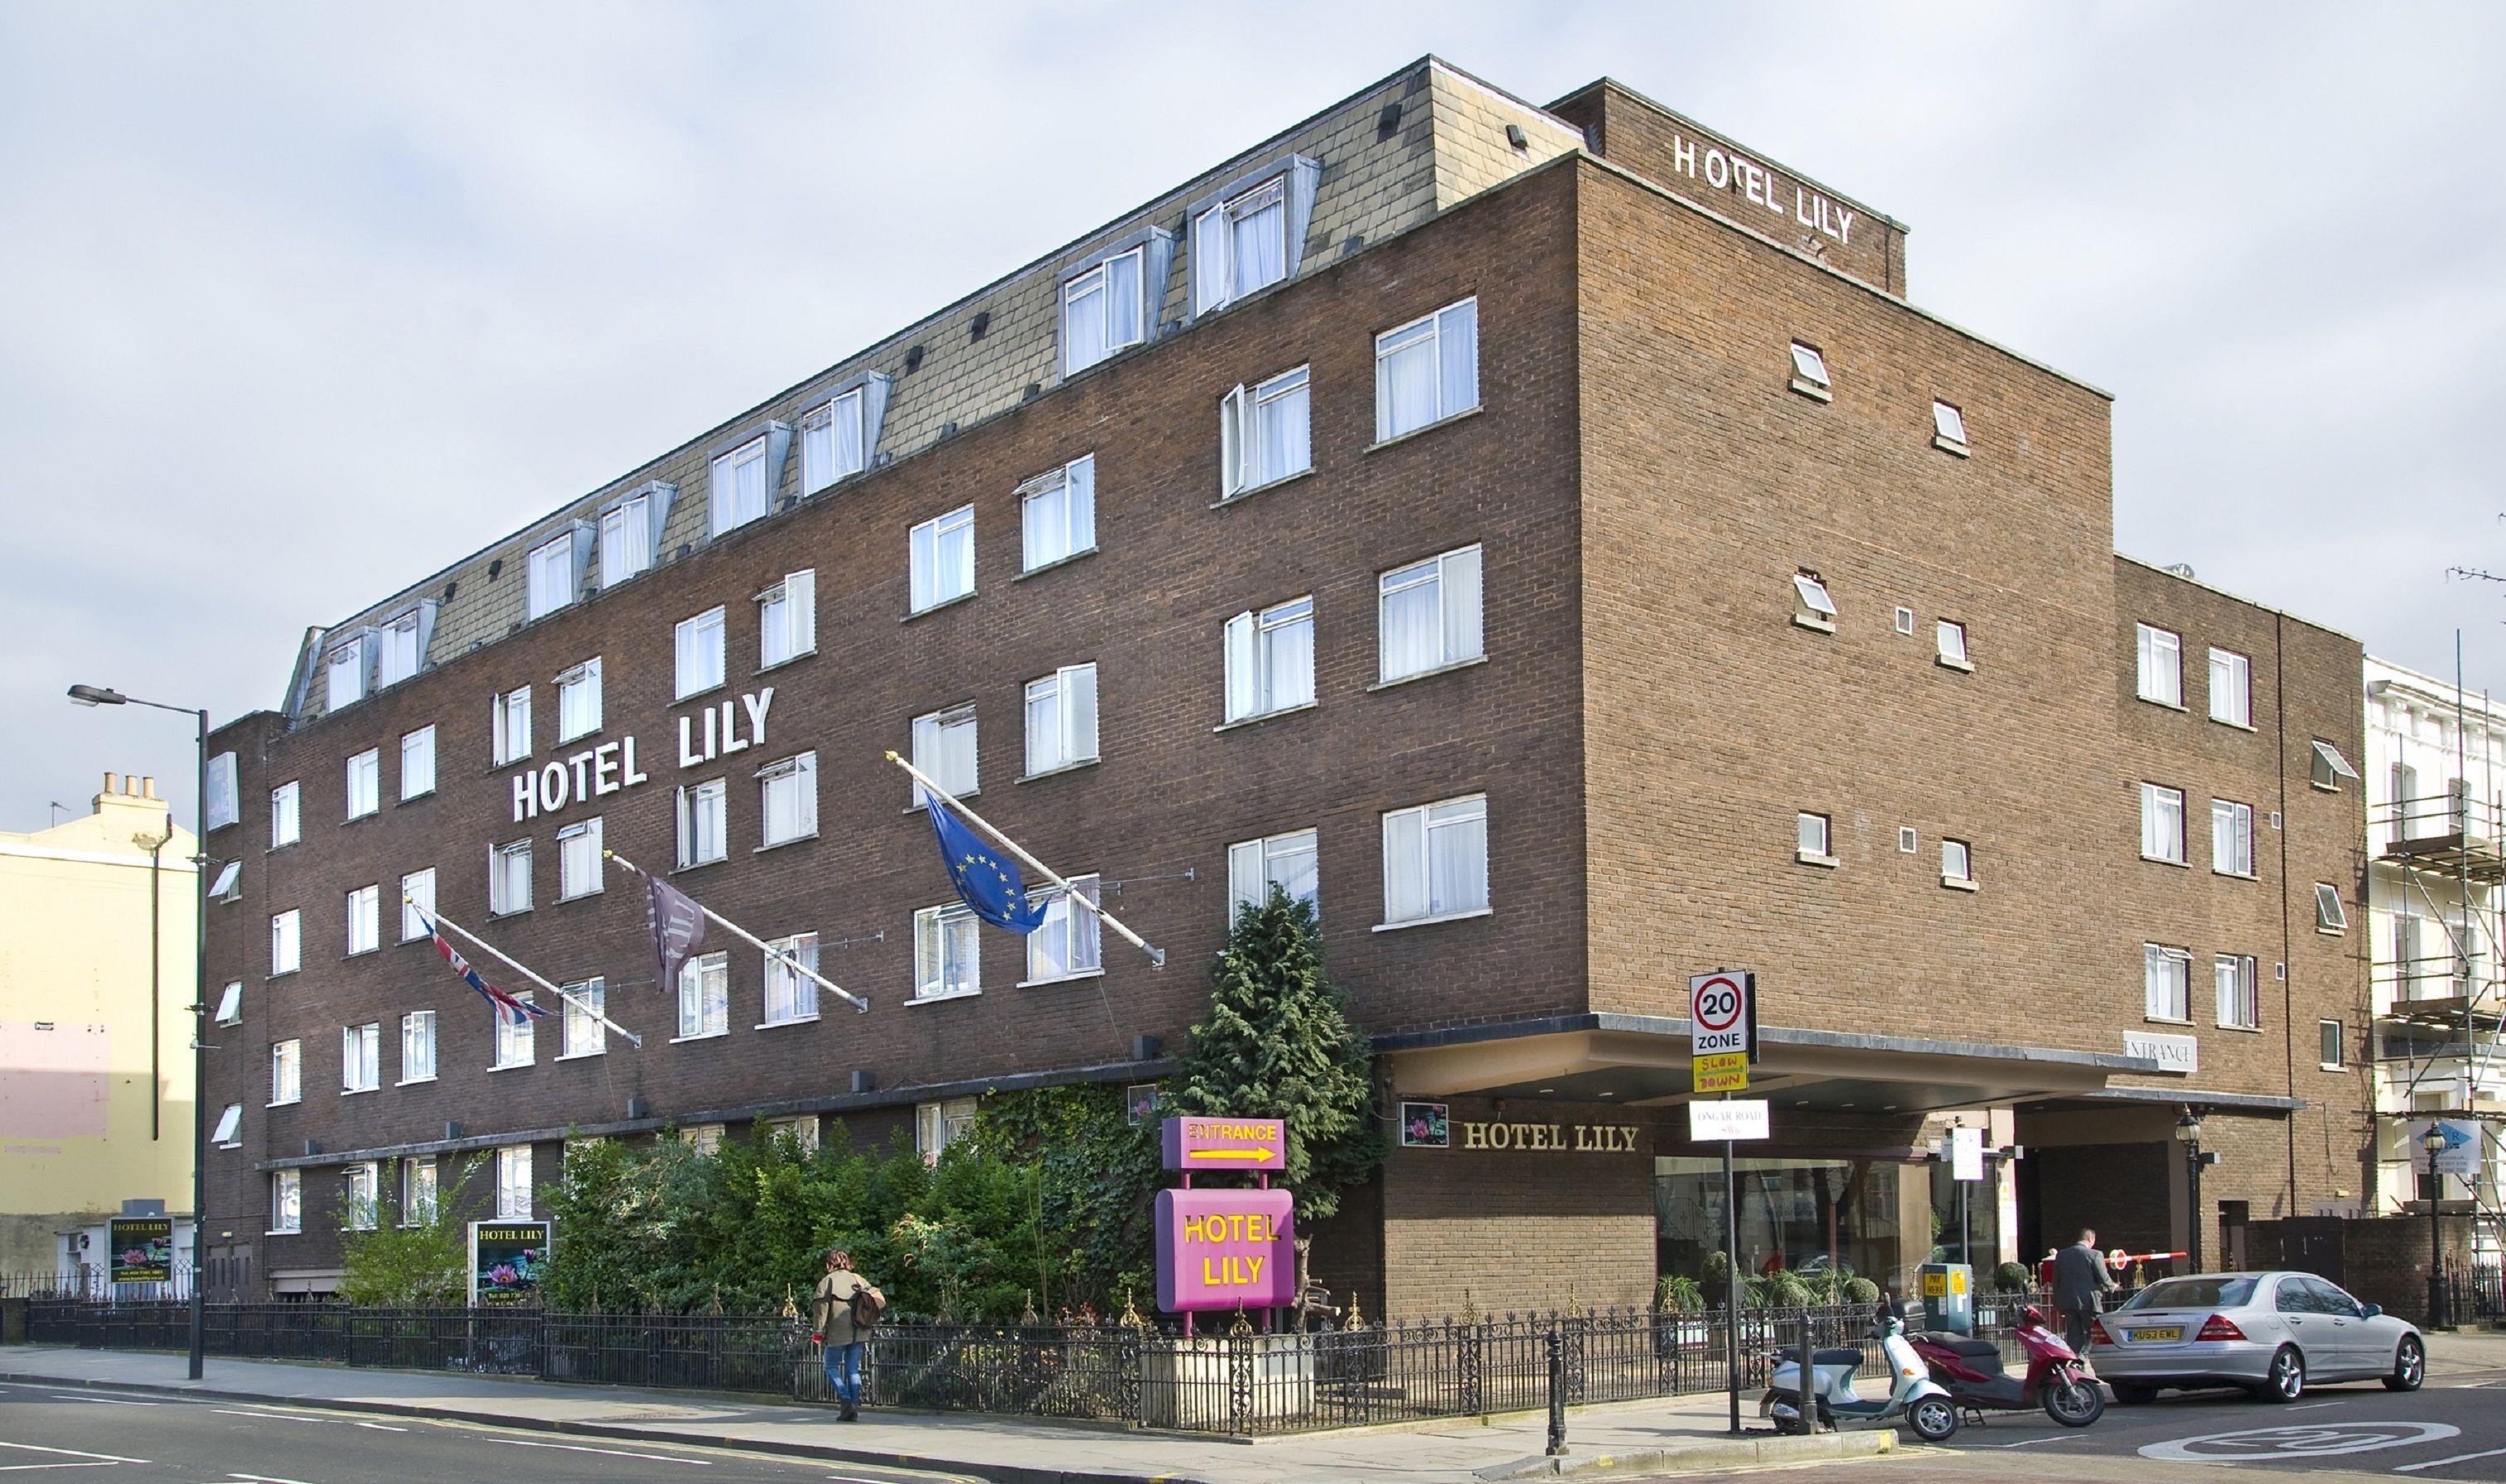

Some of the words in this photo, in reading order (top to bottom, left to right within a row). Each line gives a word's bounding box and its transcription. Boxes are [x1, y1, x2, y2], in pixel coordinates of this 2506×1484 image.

[1674, 134, 1783, 215] HOTEL
[1797, 186, 1853, 244] LILY
[513, 736, 647, 822] HOTEL
[679, 687, 775, 769] LILY
[1702, 992, 1735, 1016] 20
[1698, 1033, 1740, 1049] ZONE
[2123, 1040, 2190, 1062] ENTRANCE
[1701, 1056, 1737, 1071] SLOW
[1700, 1074, 1740, 1090] DOWN
[1697, 1111, 1732, 1121] ONGAR
[1735, 1110, 1762, 1121] ROAD
[1189, 1124, 1277, 1141] ENTRANCE
[1463, 1122, 1567, 1150] HOTEL
[1575, 1125, 1639, 1152] LILY
[114, 1223, 147, 1231] HOTEL
[479, 1230, 518, 1240] HOTEL
[520, 1230, 544, 1240] LILY
[1184, 1214, 1282, 1243] HOTEL
[1203, 1255, 1265, 1286] LILY
[1928, 1274, 1942, 1283] PAY
[1927, 1285, 1943, 1294] HERE
